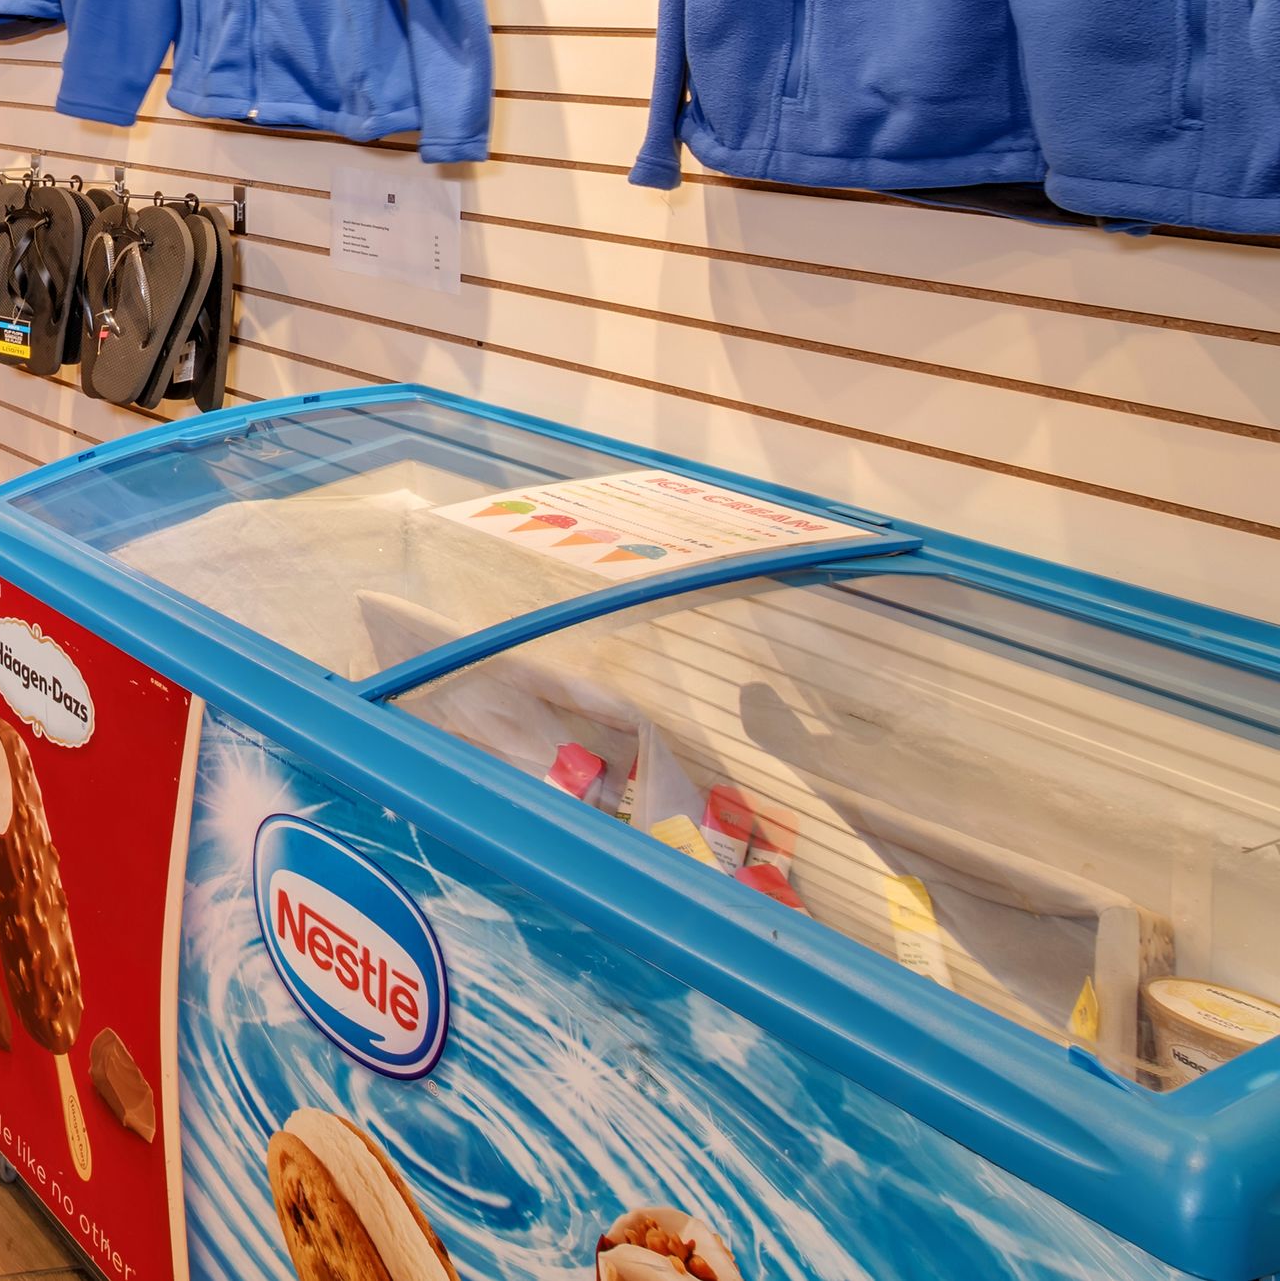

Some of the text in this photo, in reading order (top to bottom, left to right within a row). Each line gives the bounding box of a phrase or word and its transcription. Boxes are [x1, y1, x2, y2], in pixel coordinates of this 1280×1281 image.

[645, 477, 704, 495] ICE
[702, 495, 829, 531] CREAM
[17, 1135, 46, 1184] like
[52, 1180, 74, 1215] no
[79, 1214, 132, 1281] other
